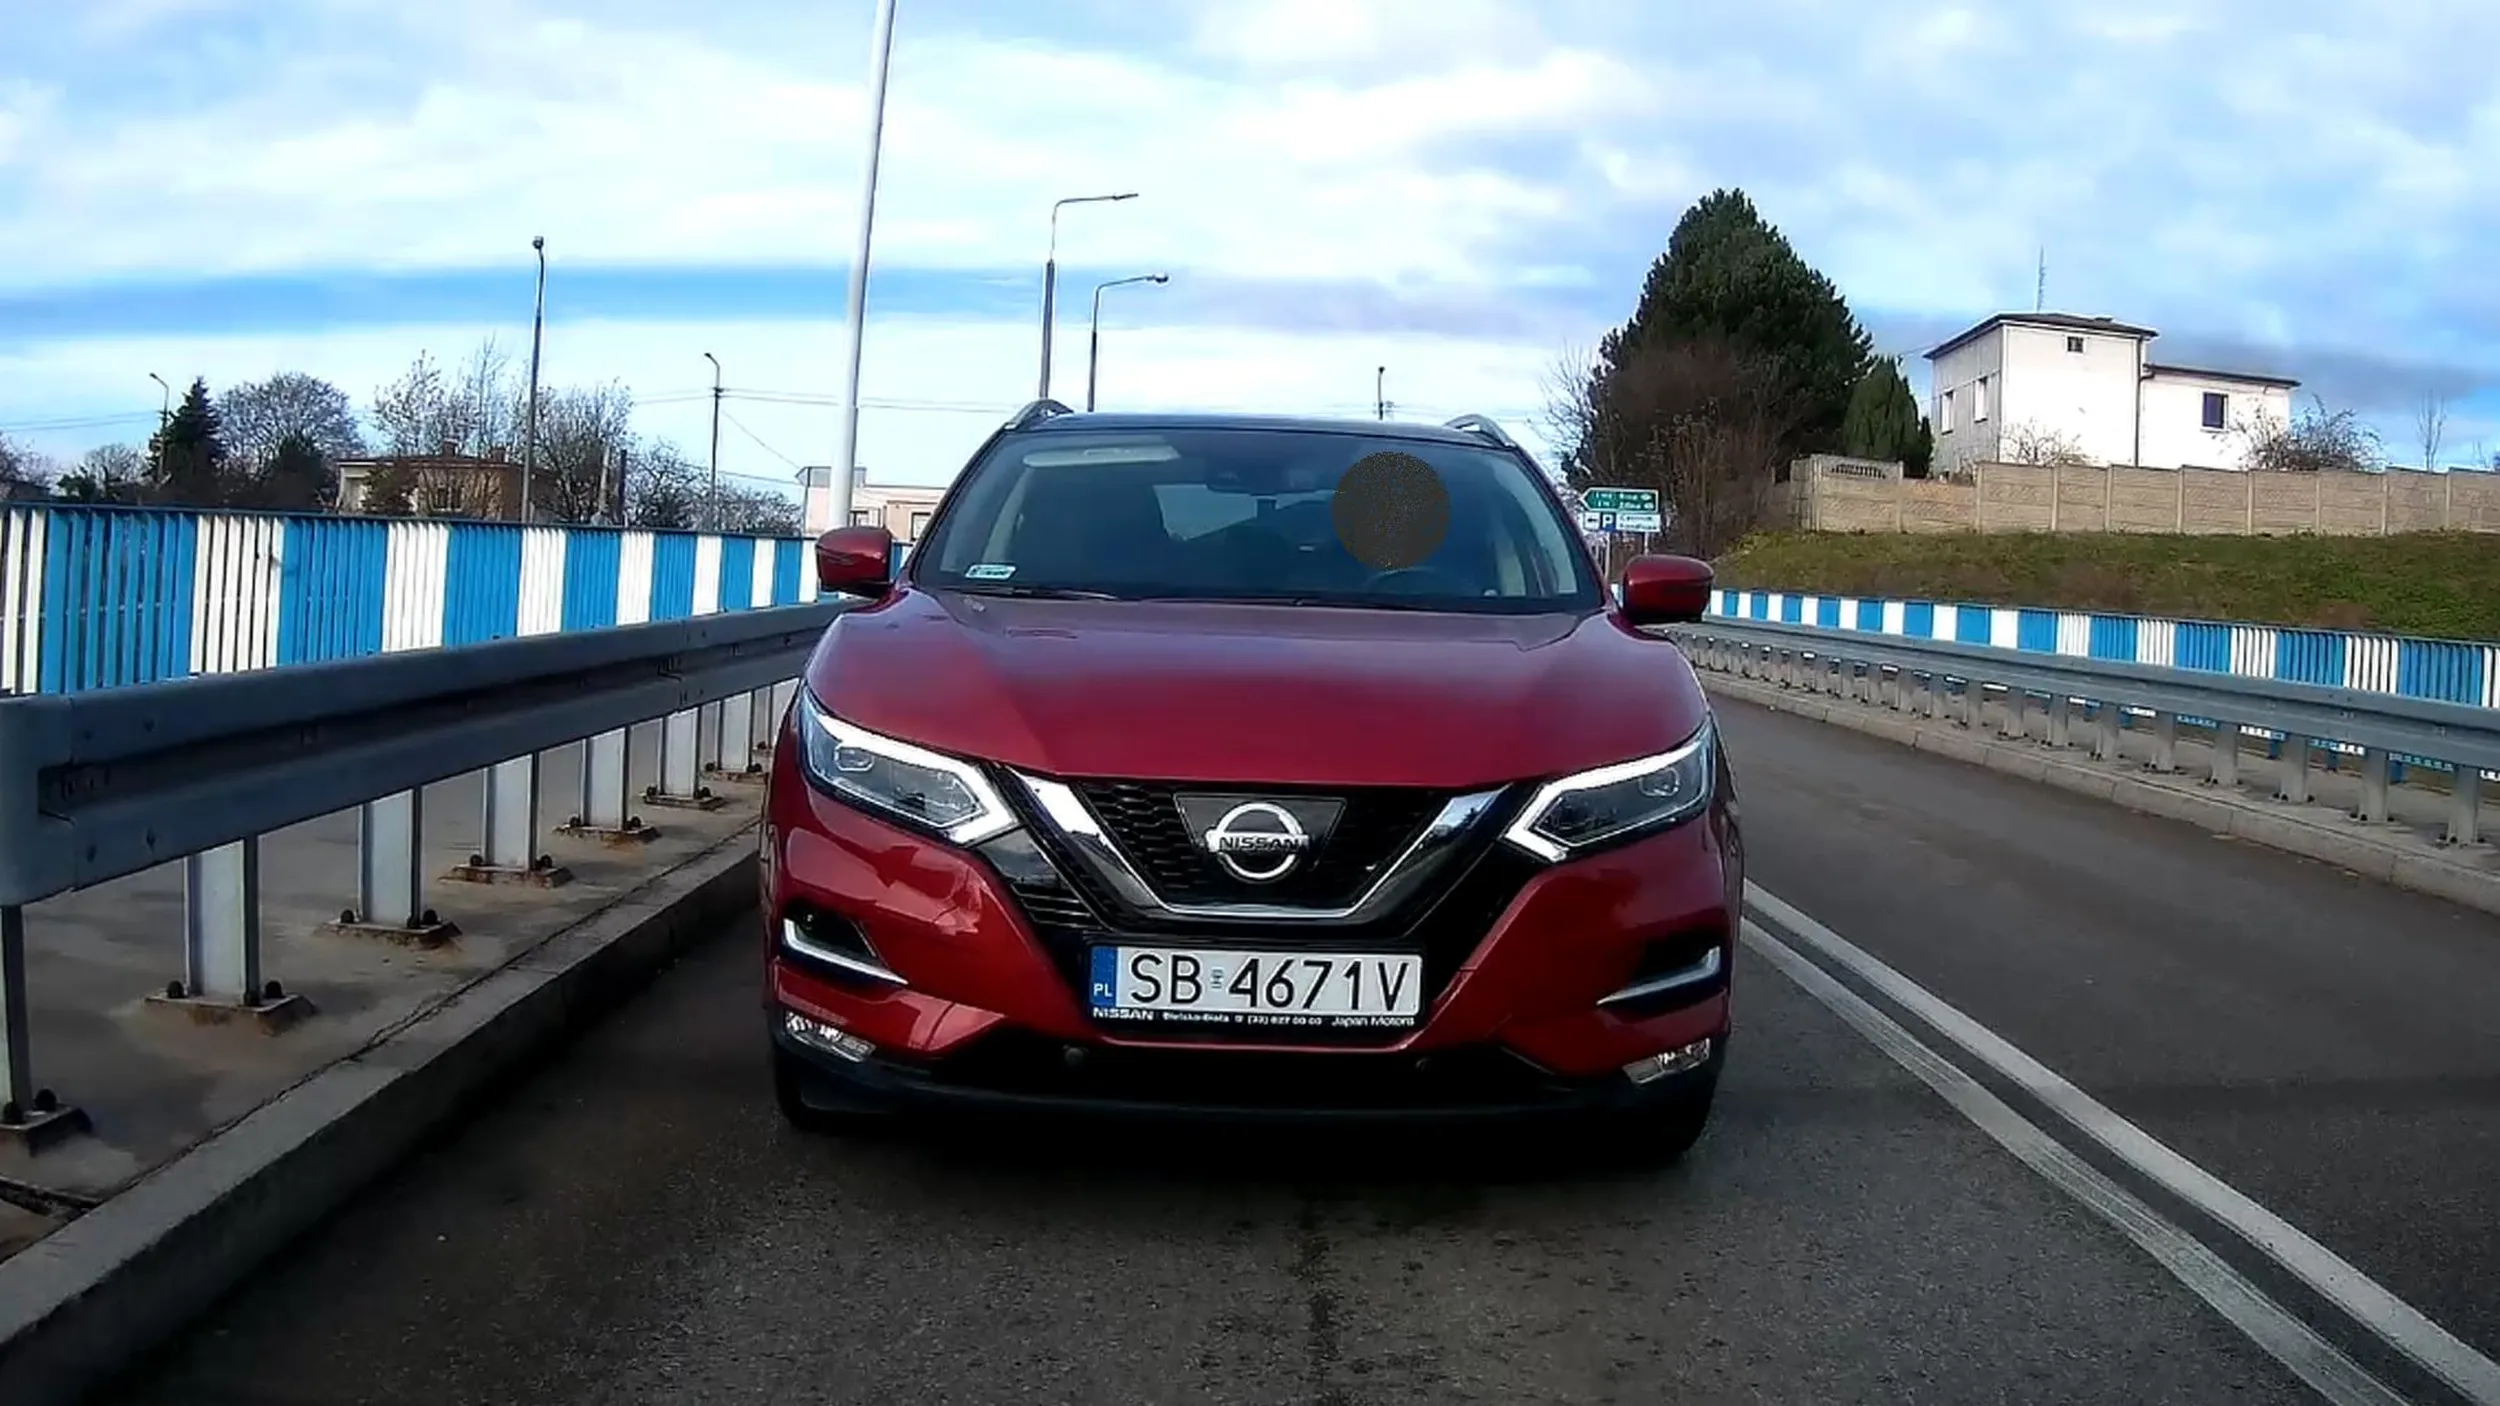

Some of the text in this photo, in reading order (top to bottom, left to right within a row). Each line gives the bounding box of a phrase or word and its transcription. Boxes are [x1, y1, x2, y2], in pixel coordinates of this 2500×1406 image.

[1219, 836, 1299, 850] NISSAN
[1093, 983, 1113, 997] PL
[1130, 953, 1409, 1010] SB 4671V
[1093, 1007, 1154, 1020] NISSAN
[1331, 1016, 1369, 1028] Japan
[1370, 1016, 1415, 1027] Motors
